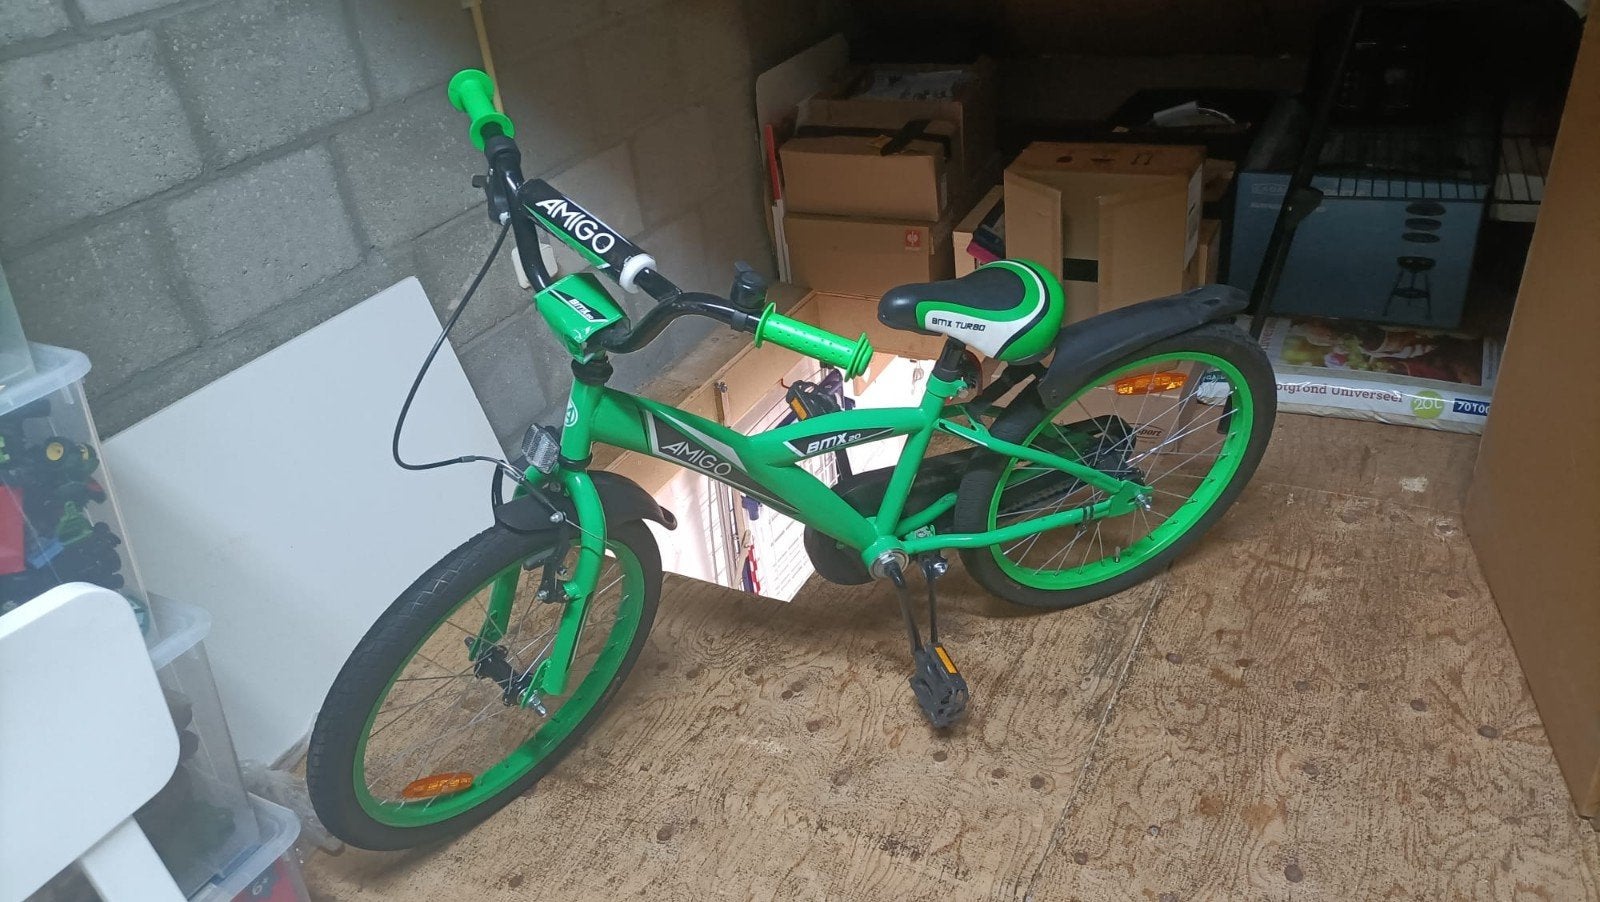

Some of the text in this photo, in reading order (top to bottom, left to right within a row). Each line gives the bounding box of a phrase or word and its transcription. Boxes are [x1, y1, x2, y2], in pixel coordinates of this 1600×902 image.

[535, 199, 615, 254] AMIGO
[931, 317, 986, 332] BMX TURBO
[806, 432, 861, 454] BMX 20
[661, 441, 731, 476] AMIGO
